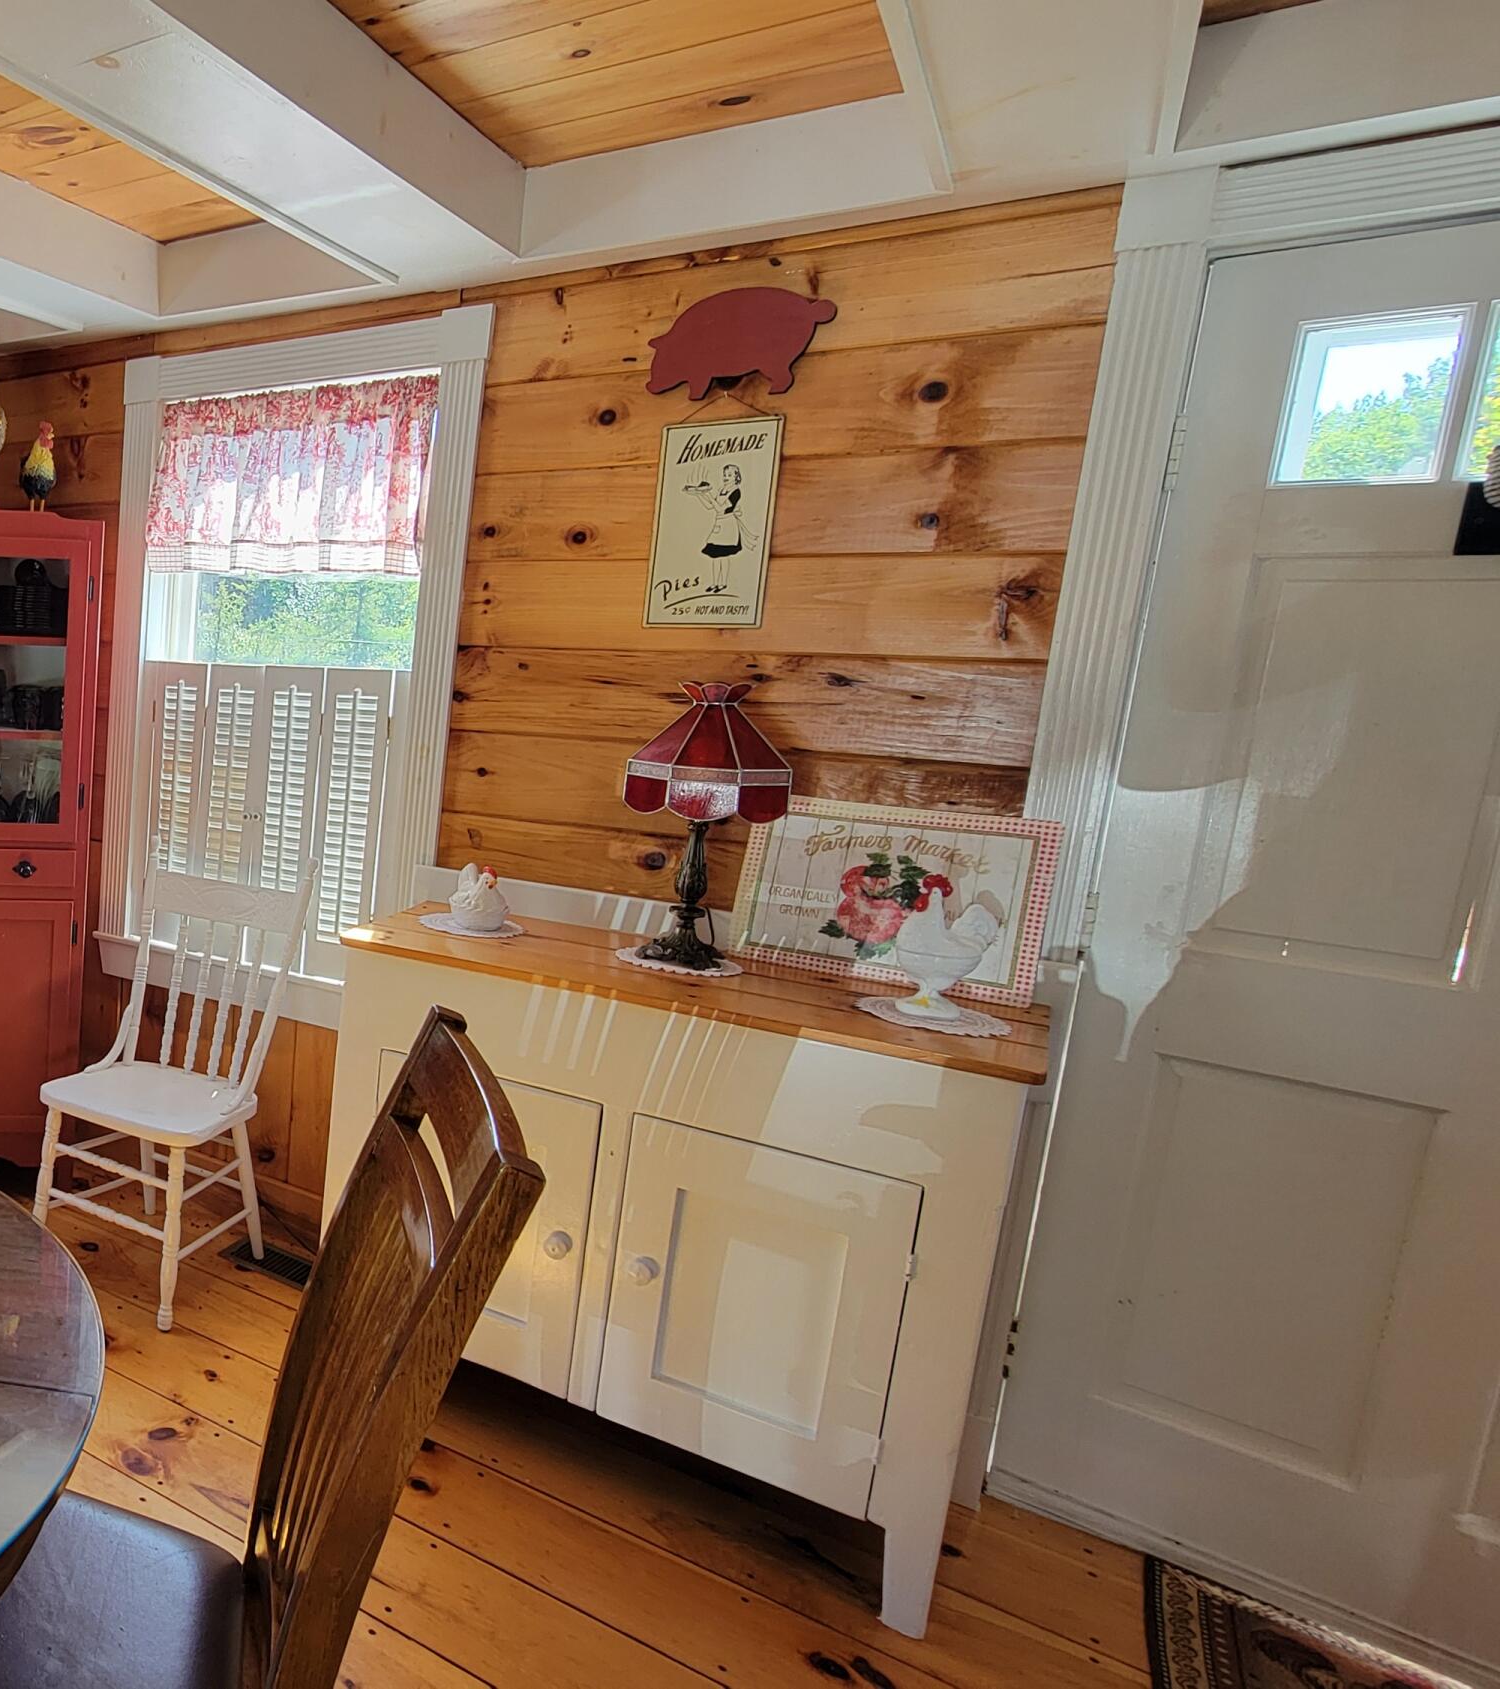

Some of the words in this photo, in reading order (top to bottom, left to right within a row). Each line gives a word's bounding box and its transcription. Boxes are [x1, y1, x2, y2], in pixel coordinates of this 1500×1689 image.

[676, 433, 768, 464] HOMEMADE
[654, 576, 700, 601] Pies
[694, 605, 710, 615] HOT
[709, 605, 725, 615] AND
[780, 904, 820, 918] GROWN
